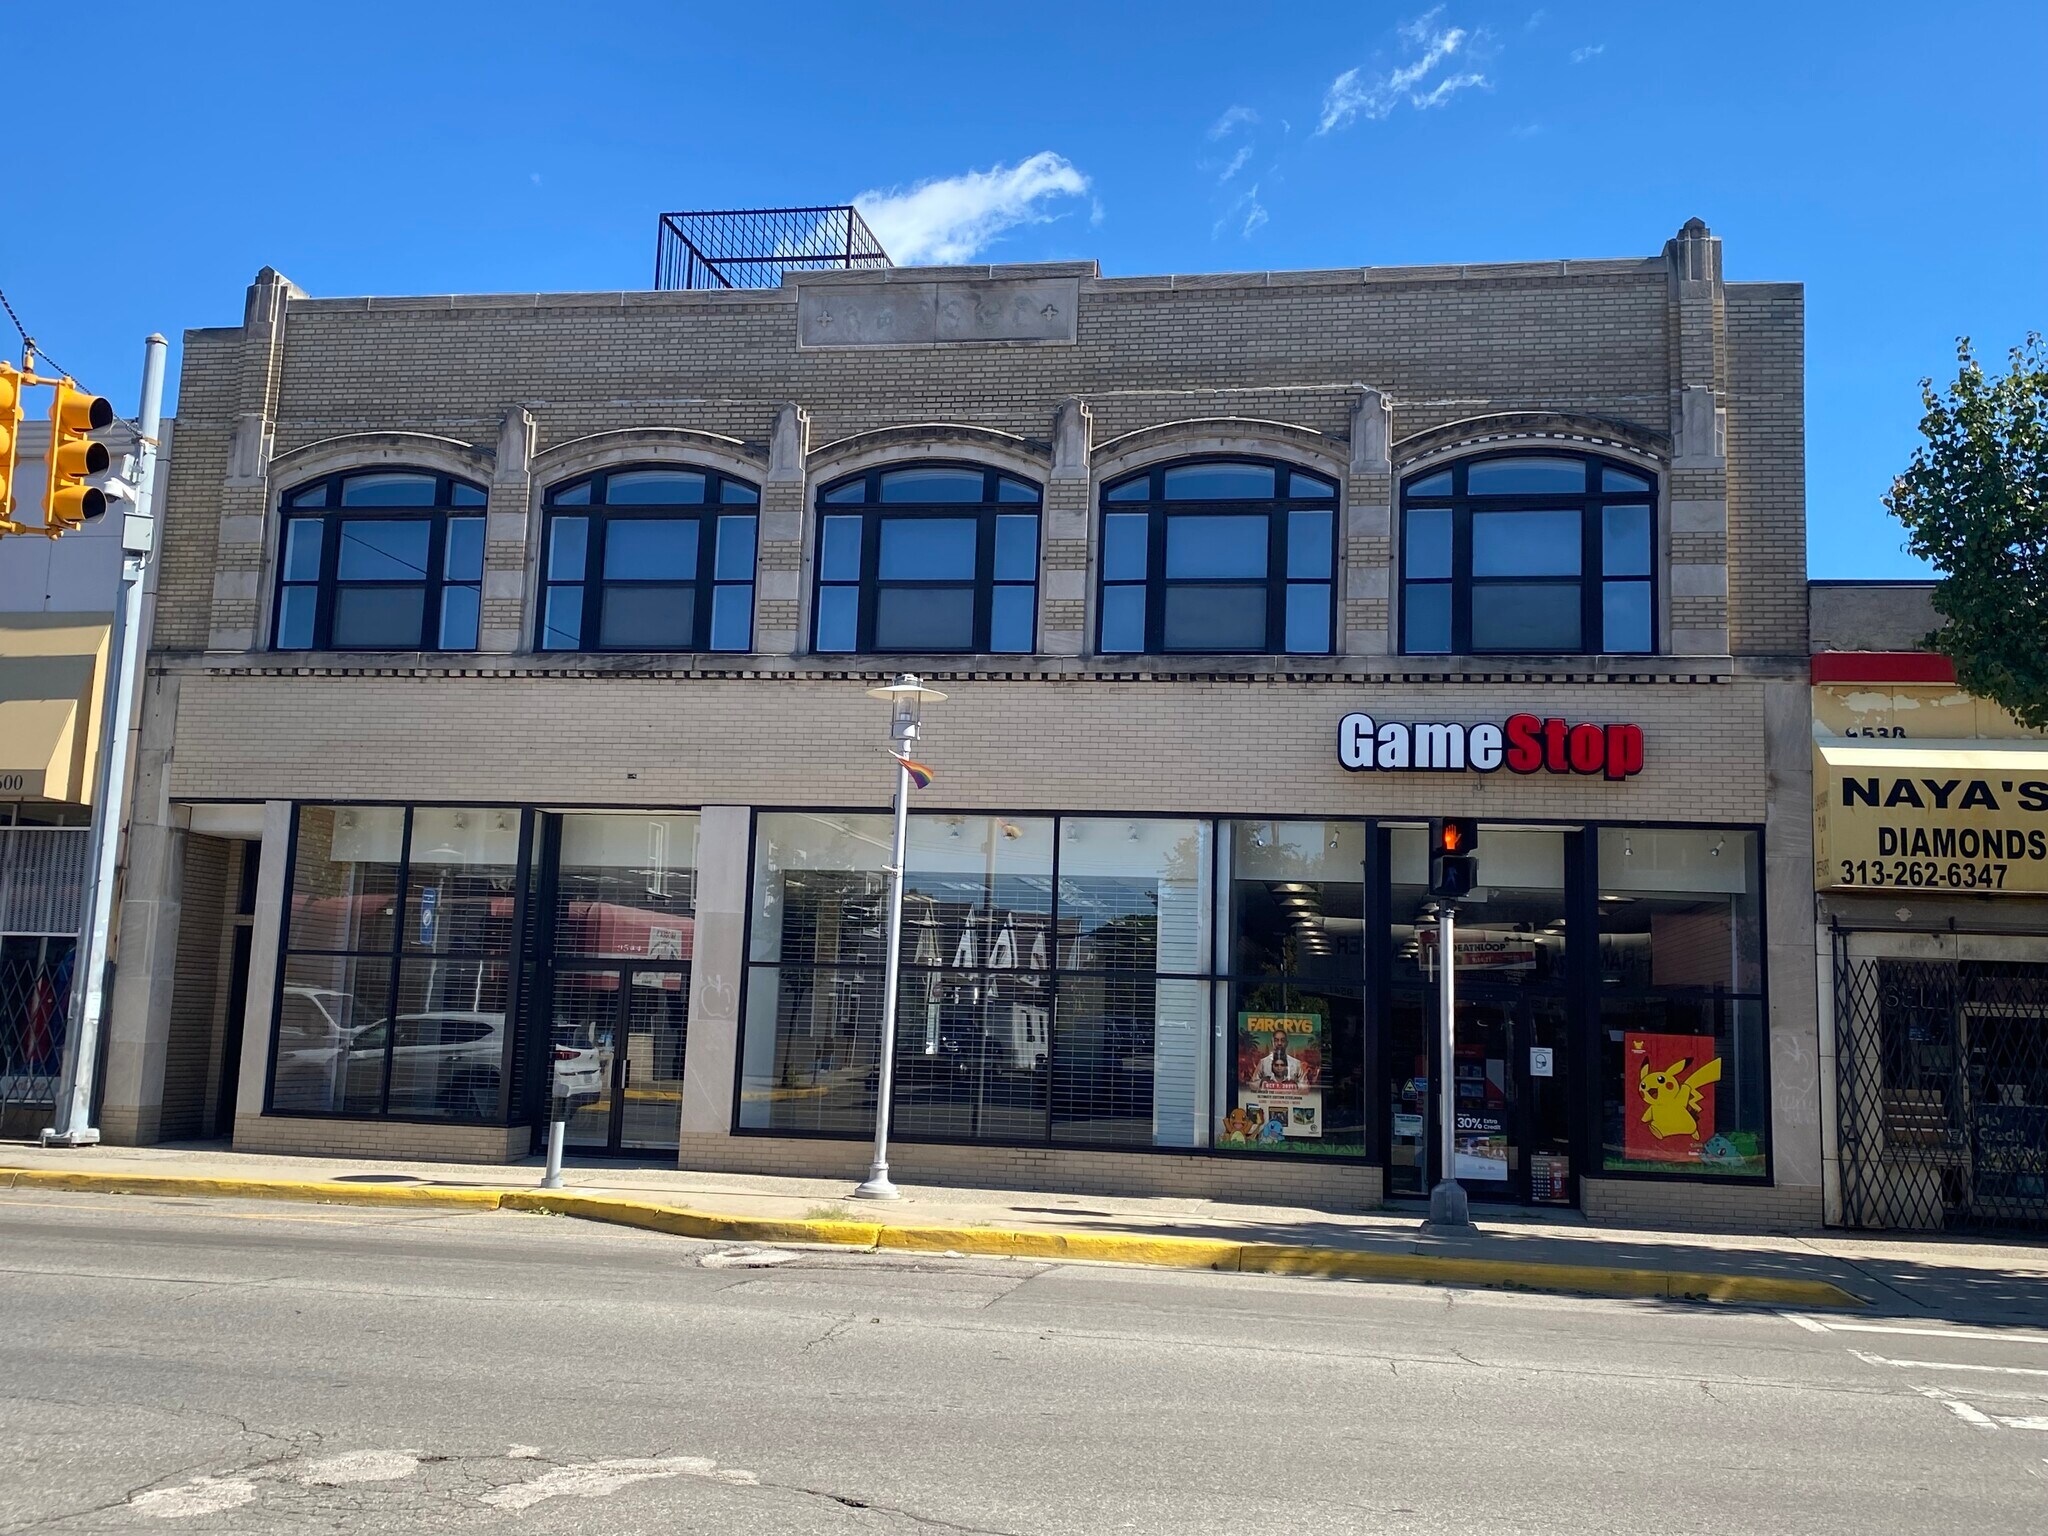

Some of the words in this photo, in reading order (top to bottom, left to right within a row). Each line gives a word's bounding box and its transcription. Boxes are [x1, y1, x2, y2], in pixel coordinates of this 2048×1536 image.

[1339, 712, 1644, 779] GameStop
[1842, 777, 2048, 811] NAYA'S
[1878, 827, 2047, 860] DIAMONDS
[1841, 860, 2008, 889] 313-262-6347
[1457, 1117, 1483, 1130] 30%
